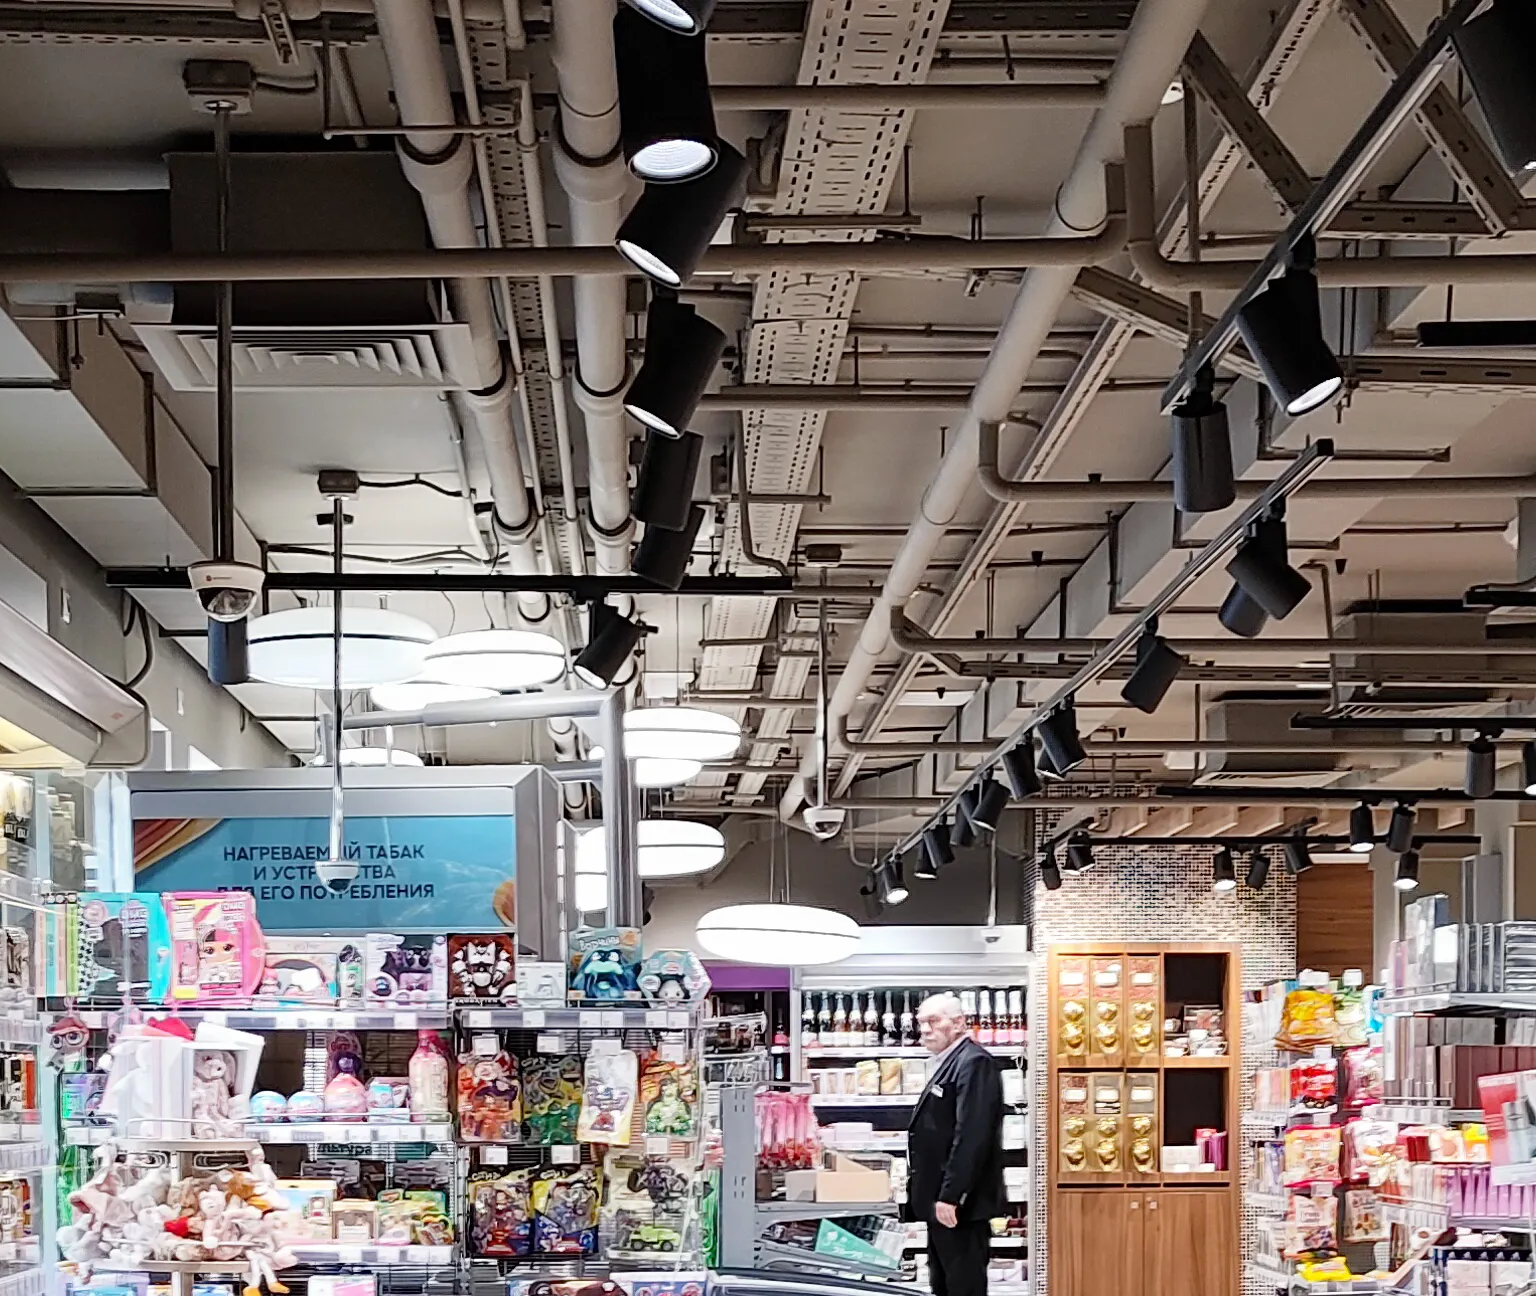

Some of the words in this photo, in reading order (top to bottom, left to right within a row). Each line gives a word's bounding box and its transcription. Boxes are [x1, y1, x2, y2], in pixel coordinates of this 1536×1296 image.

[366, 844, 424, 860] ТАБАК
[254, 866, 269, 881] И
[273, 865, 396, 881] УСТРТВА
[260, 885, 296, 900] ЕГО
[300, 884, 434, 900] ПОЕБЛЕНИЯ
